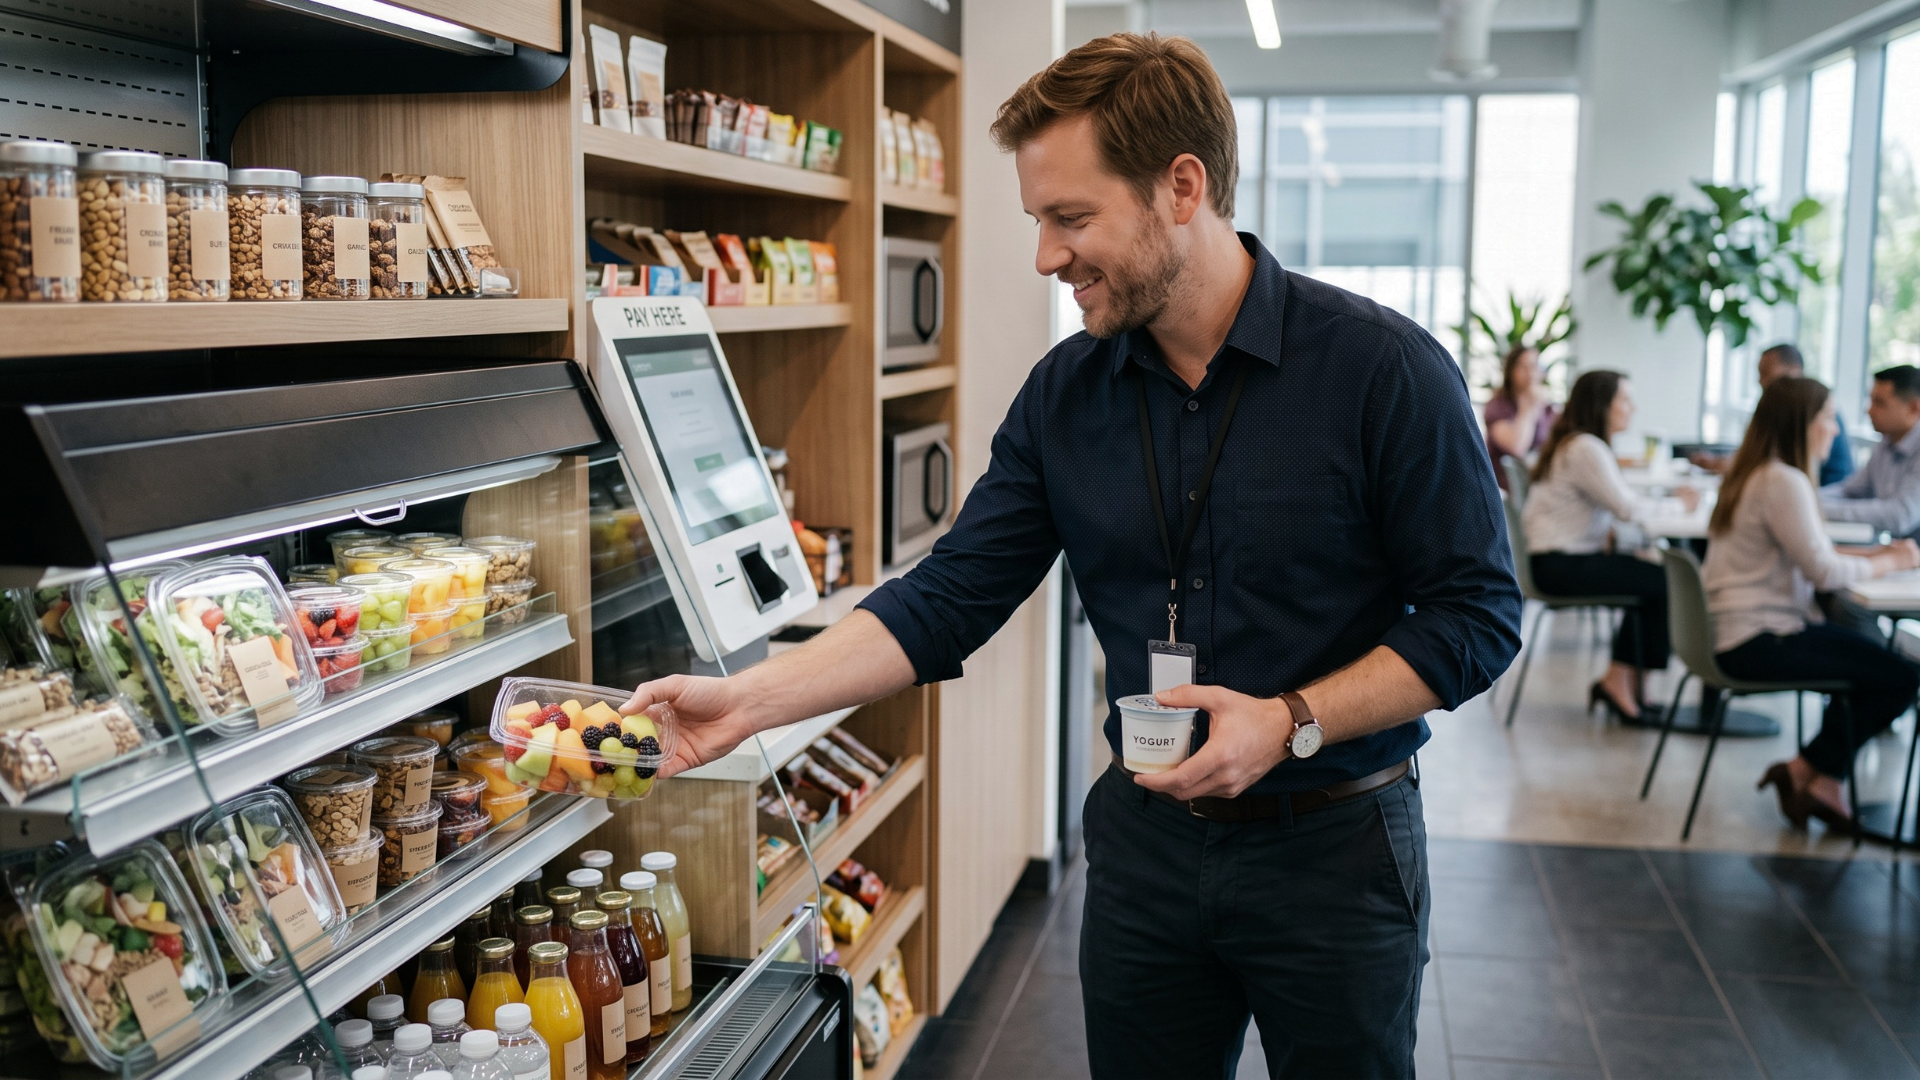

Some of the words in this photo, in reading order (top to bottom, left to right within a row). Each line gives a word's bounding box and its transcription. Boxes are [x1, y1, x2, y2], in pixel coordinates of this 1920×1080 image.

[623, 307, 650, 328] PAY
[652, 306, 687, 327] HERE
[1133, 735, 1175, 746] YOGURT
